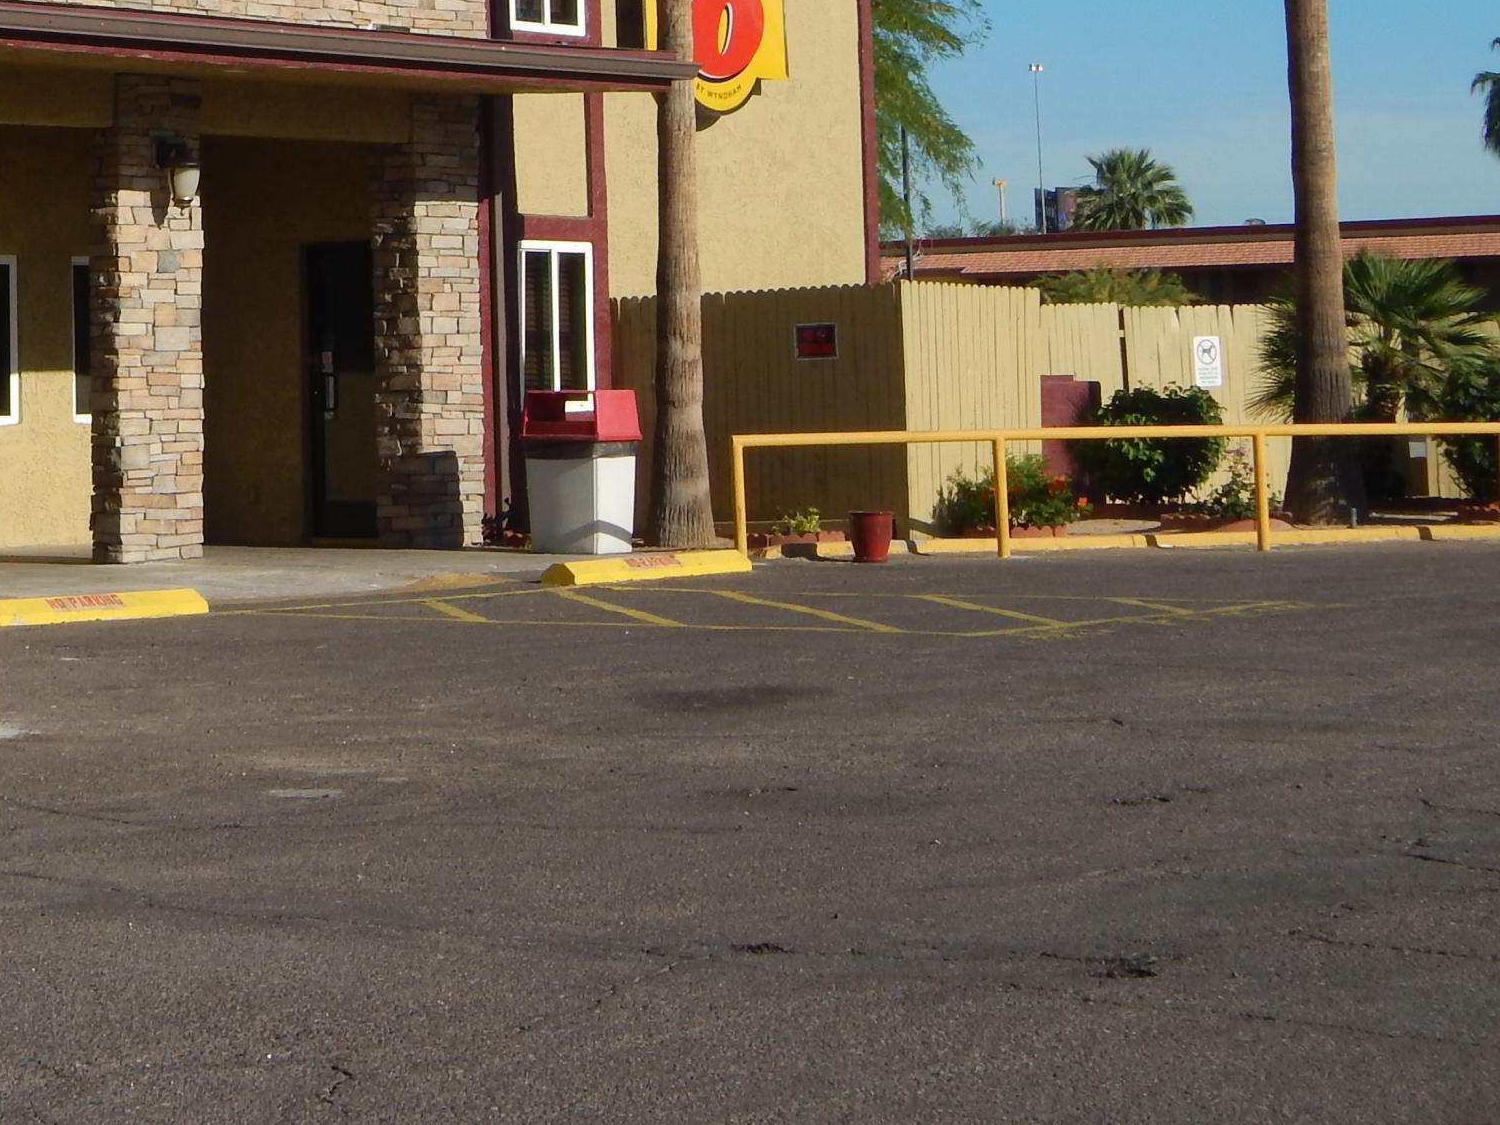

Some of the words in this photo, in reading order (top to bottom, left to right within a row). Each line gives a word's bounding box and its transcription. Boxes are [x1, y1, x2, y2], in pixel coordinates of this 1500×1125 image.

[707, 83, 742, 100] WYNDHAM
[45, 598, 66, 609] NO
[69, 594, 124, 609] PARKING
